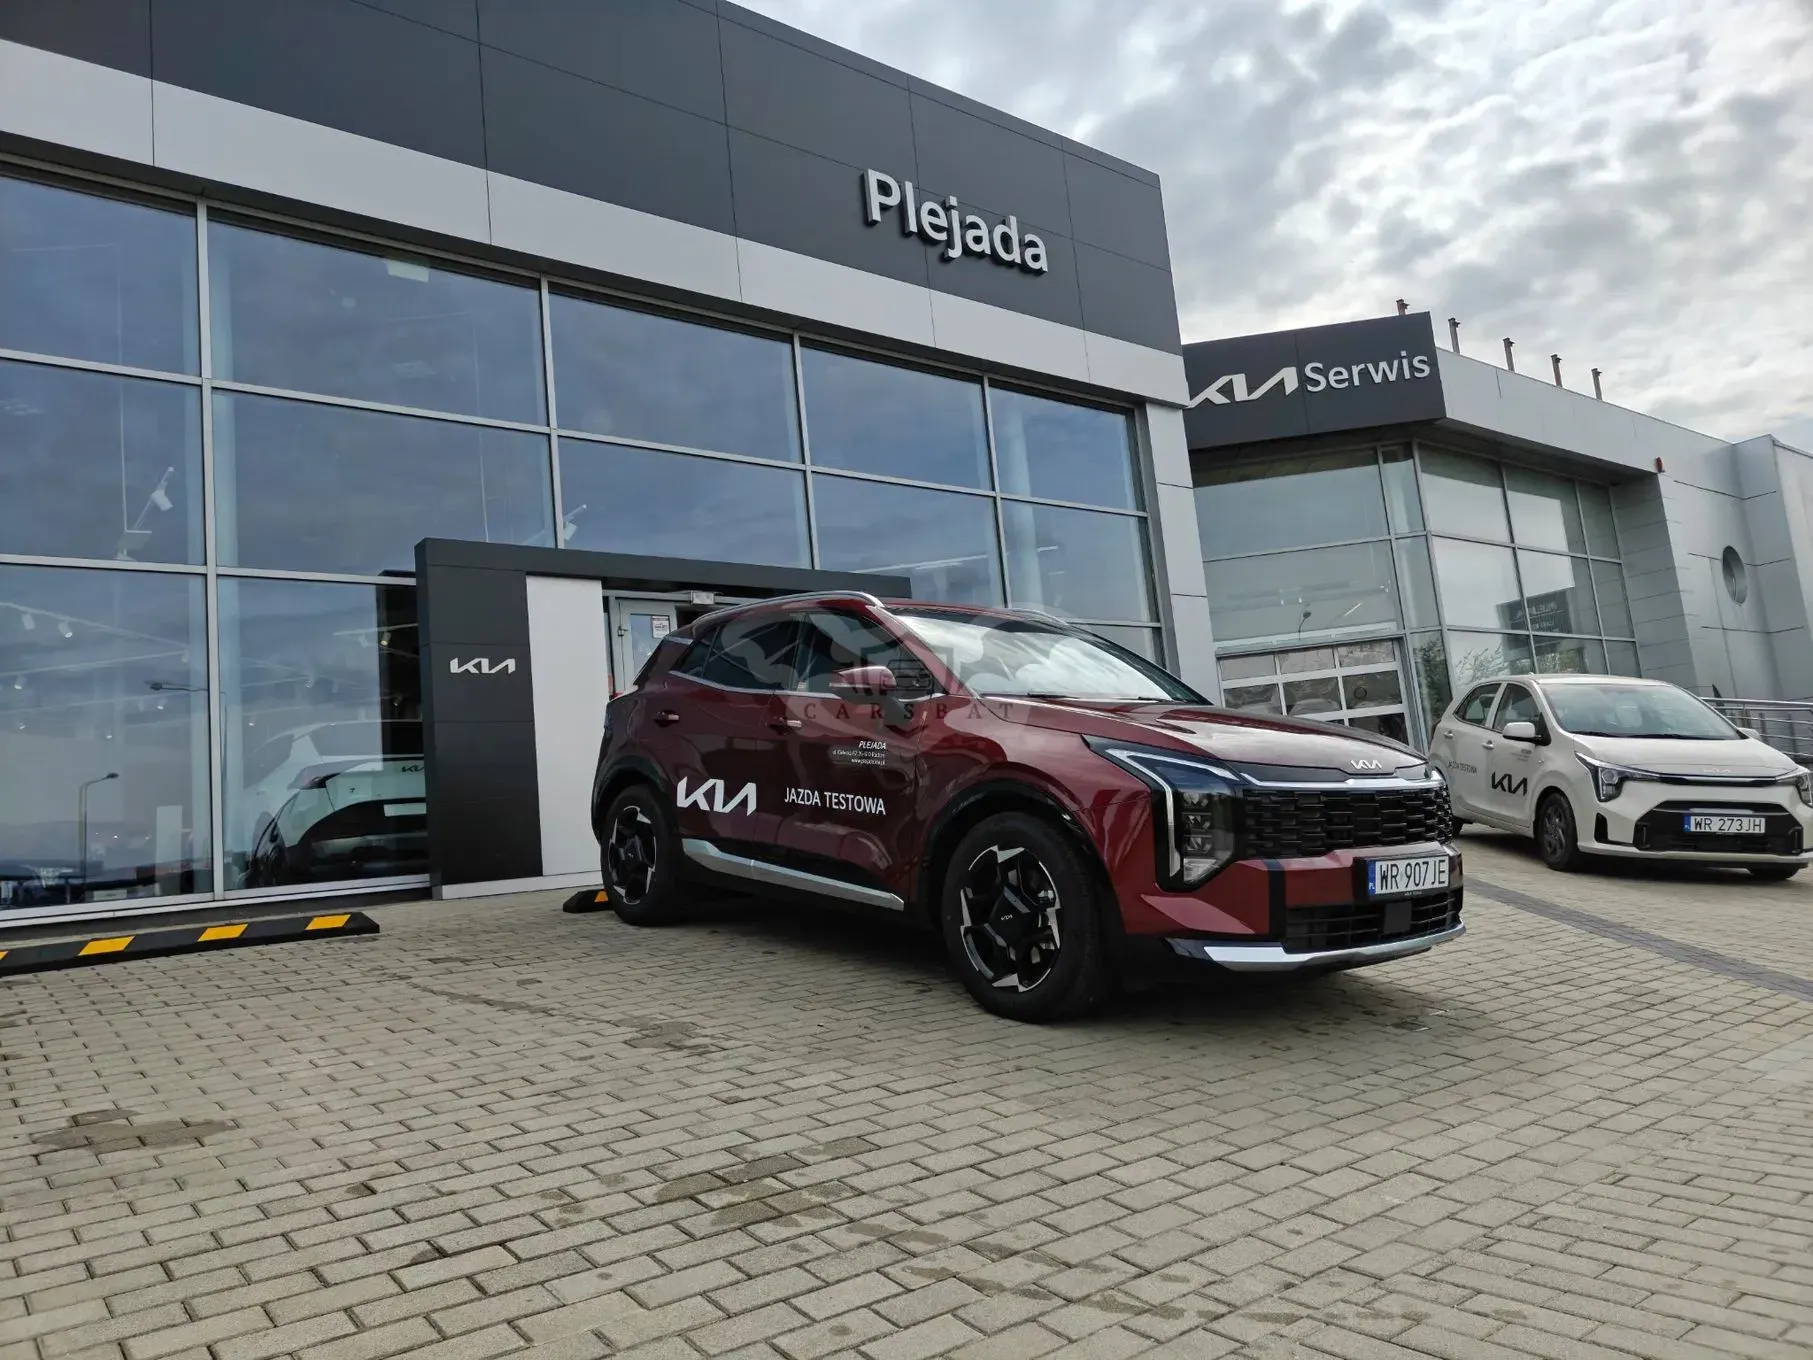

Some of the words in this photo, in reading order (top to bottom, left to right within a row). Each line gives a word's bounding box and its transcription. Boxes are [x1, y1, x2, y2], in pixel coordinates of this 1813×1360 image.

[864, 168, 1048, 273] Plejada
[1304, 350, 1431, 393] Serwis
[450, 657, 516, 674] KIA
[858, 740, 887, 750] PLEJADA
[676, 776, 757, 816] KIA
[1491, 772, 1528, 796] KIA
[784, 787, 821, 807] JAZDA
[824, 791, 886, 815] TESTOWA
[1694, 818, 1712, 831] WR
[1718, 818, 1762, 832] 273JH
[1379, 863, 1399, 890] WR
